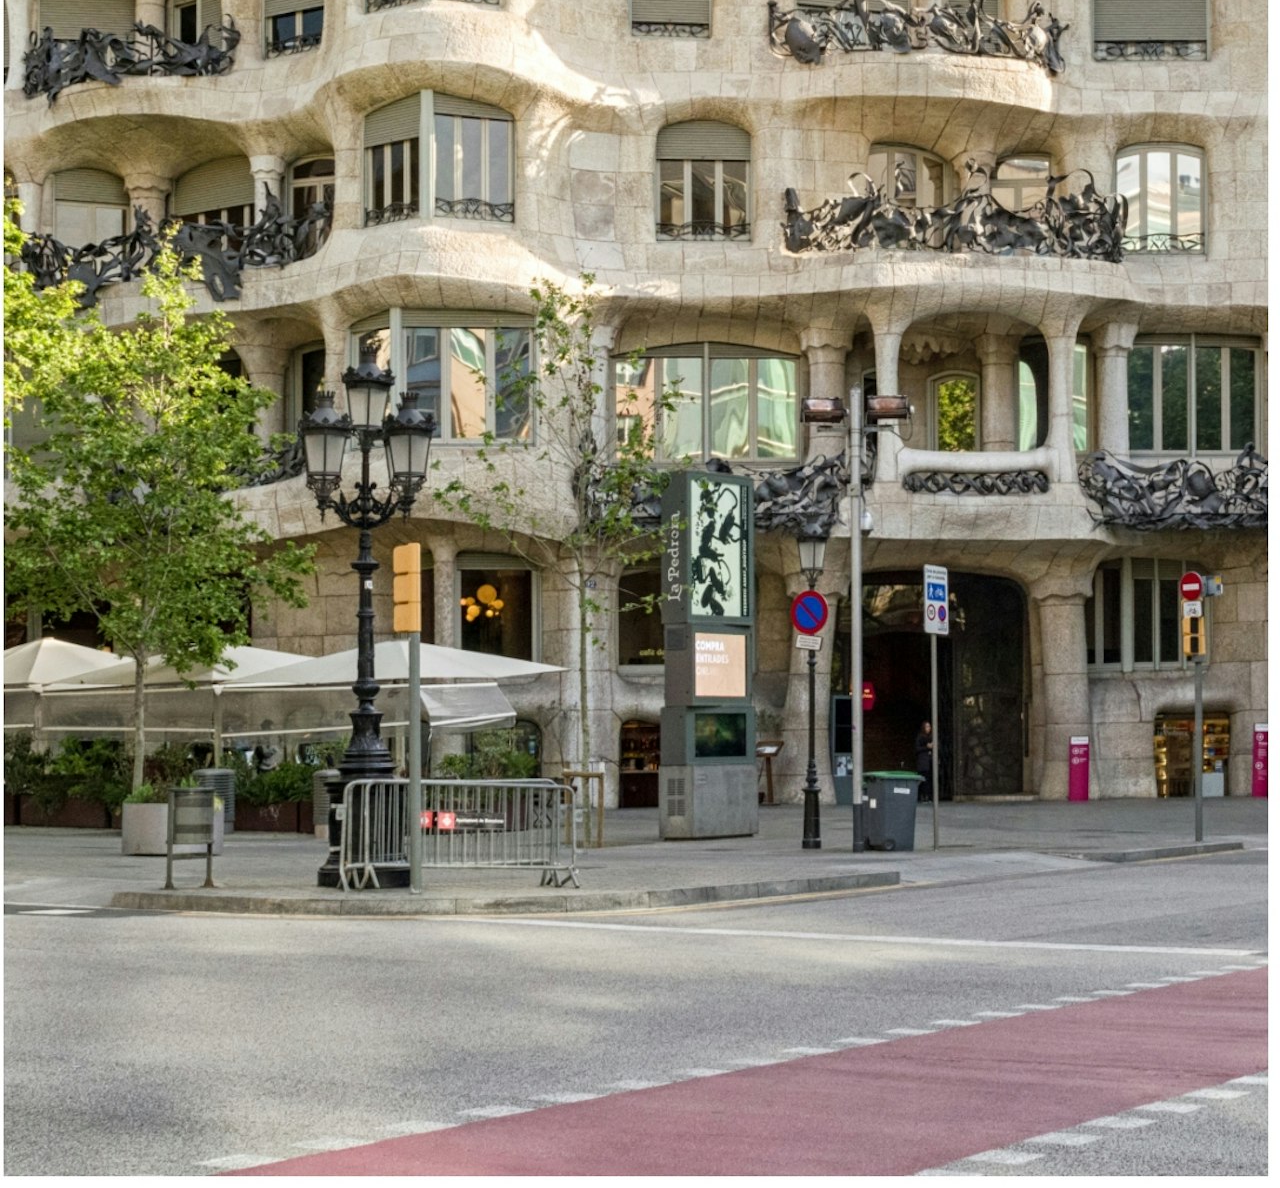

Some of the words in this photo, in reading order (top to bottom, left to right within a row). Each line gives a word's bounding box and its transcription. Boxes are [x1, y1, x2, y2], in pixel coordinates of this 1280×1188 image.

[667, 510, 681, 582] Pedrera
[667, 583, 682, 602] La
[695, 640, 724, 651] COMPRA
[695, 653, 729, 664] ENTRADES
